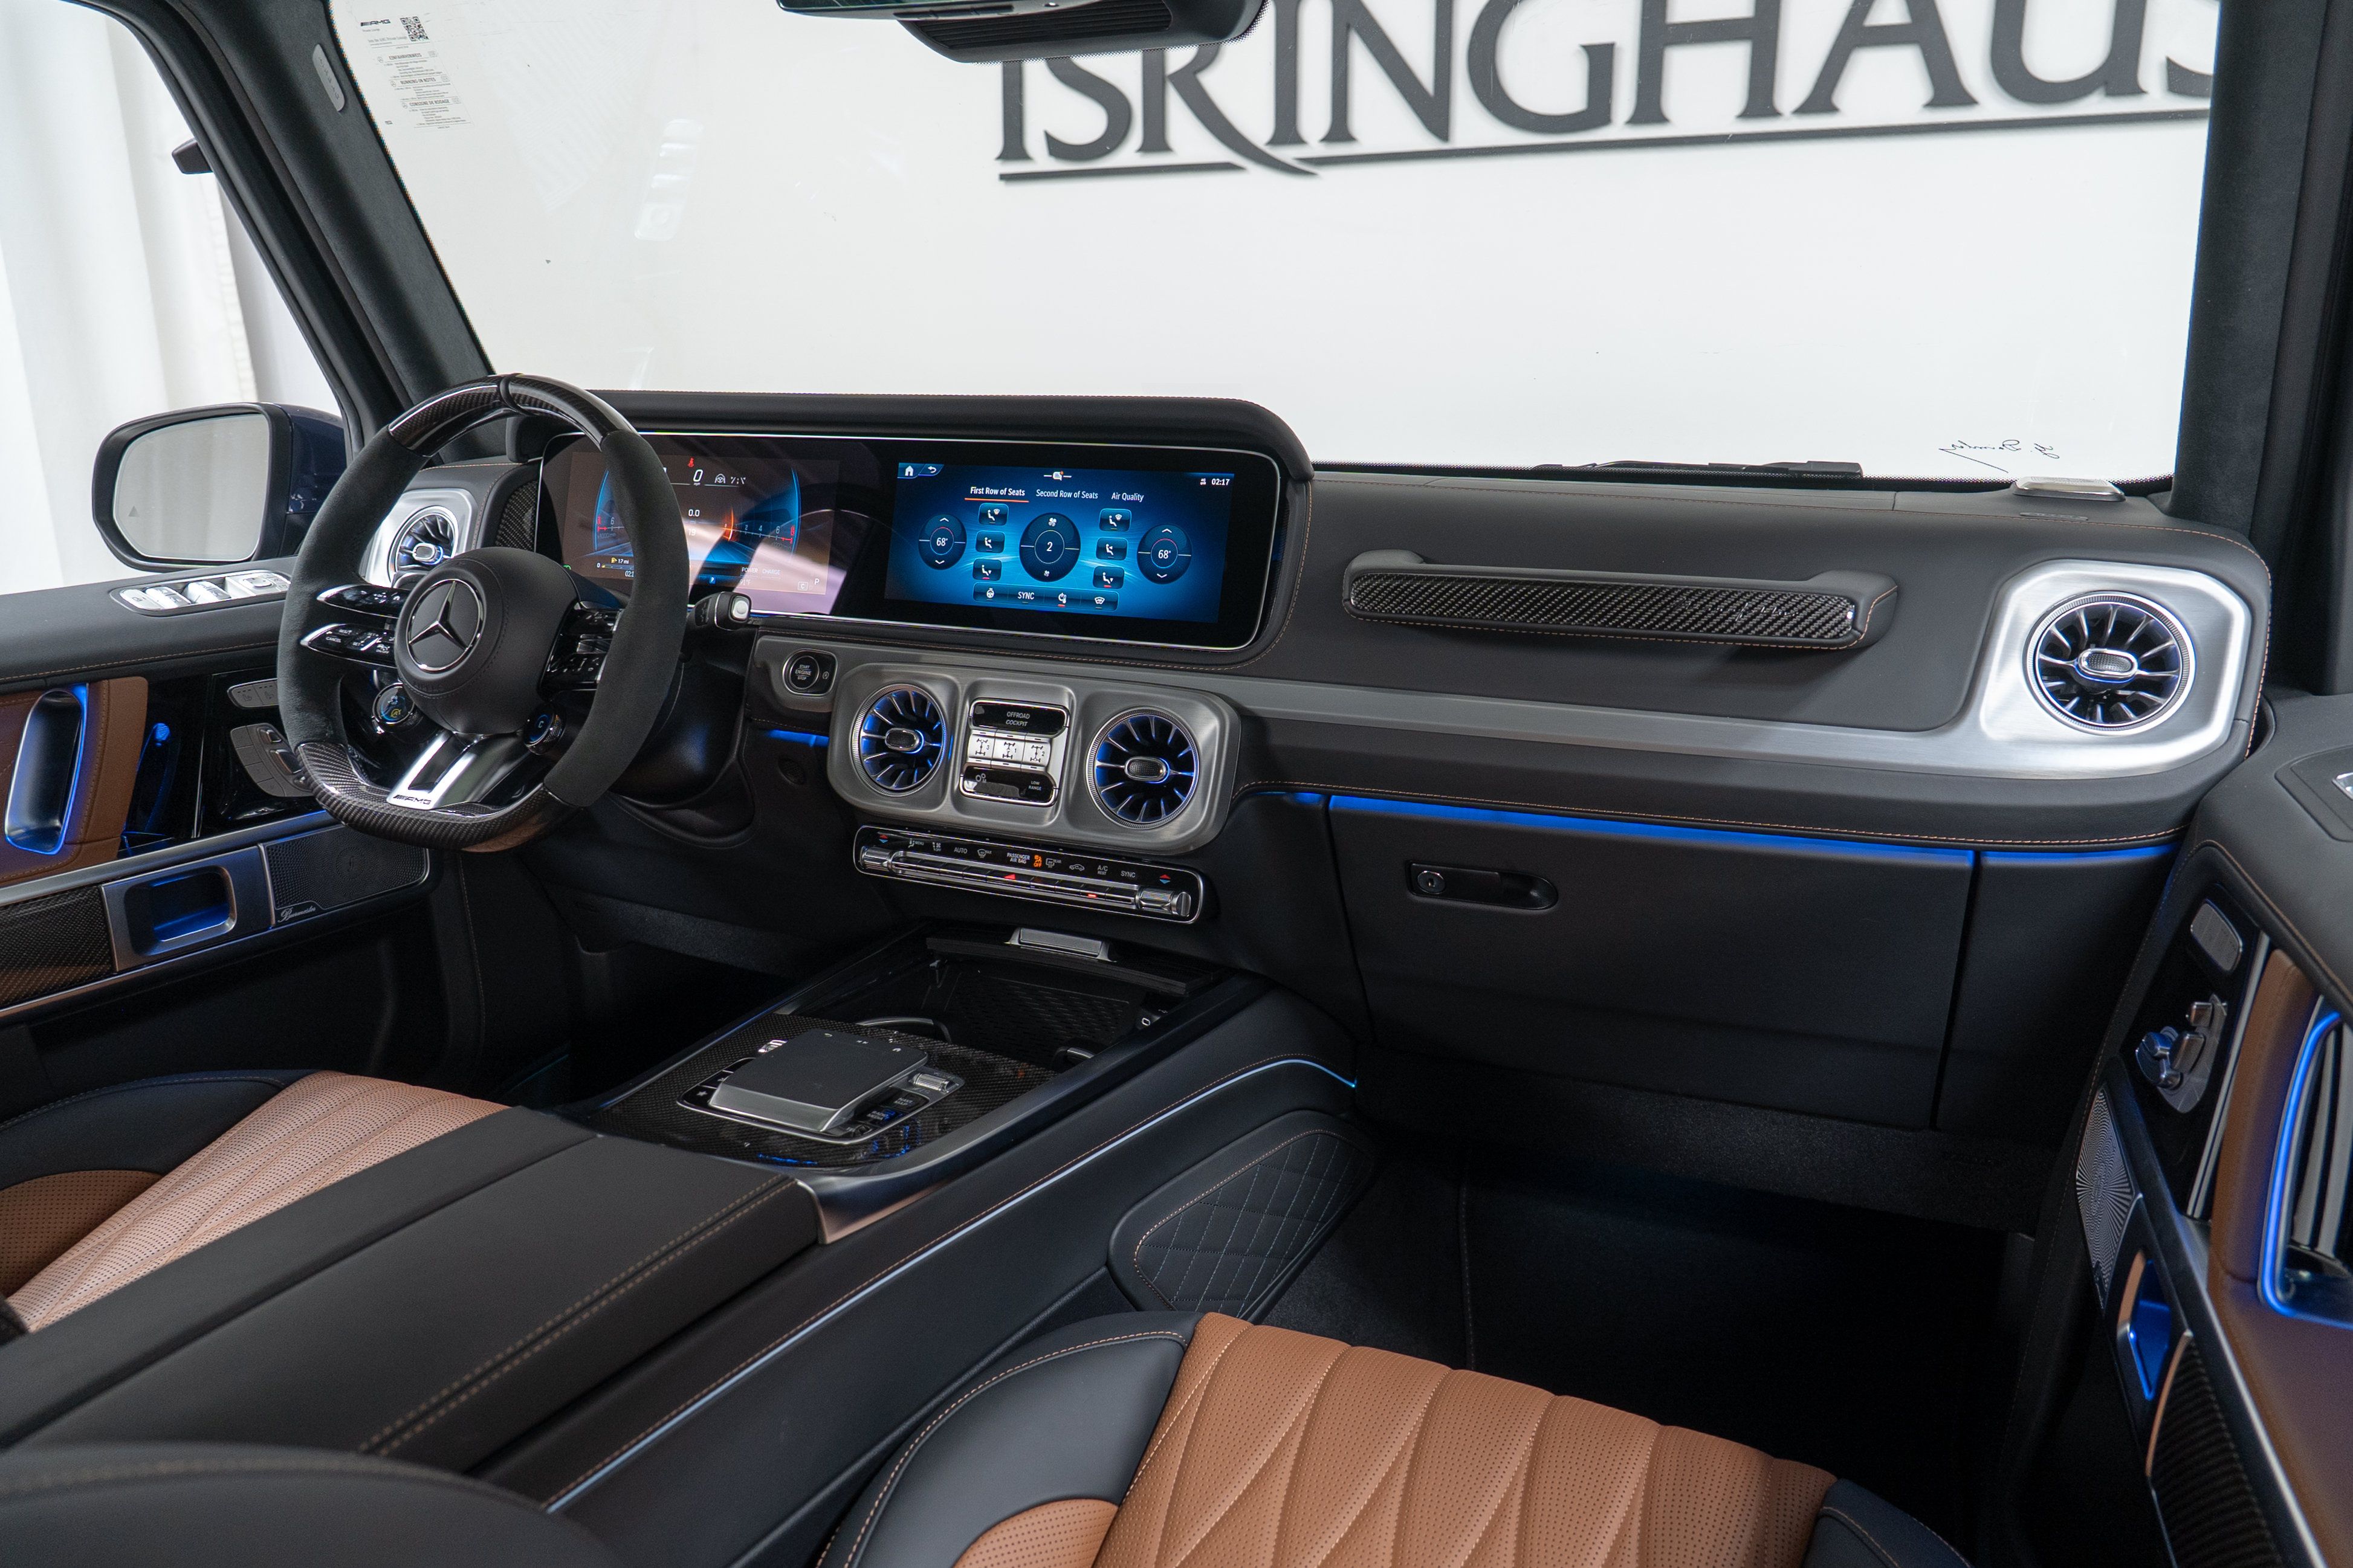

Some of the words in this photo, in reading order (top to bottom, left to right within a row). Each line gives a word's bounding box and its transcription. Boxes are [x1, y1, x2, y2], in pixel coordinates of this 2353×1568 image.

[693, 469, 704, 482] 0
[1112, 492, 1121, 500] Air
[1122, 492, 1144, 502] Quality
[1046, 541, 1052, 552] 2
[1017, 591, 1035, 601] SYNC
[1006, 711, 1030, 720] OFFROAD
[1006, 852, 1031, 860] PASSENGER
